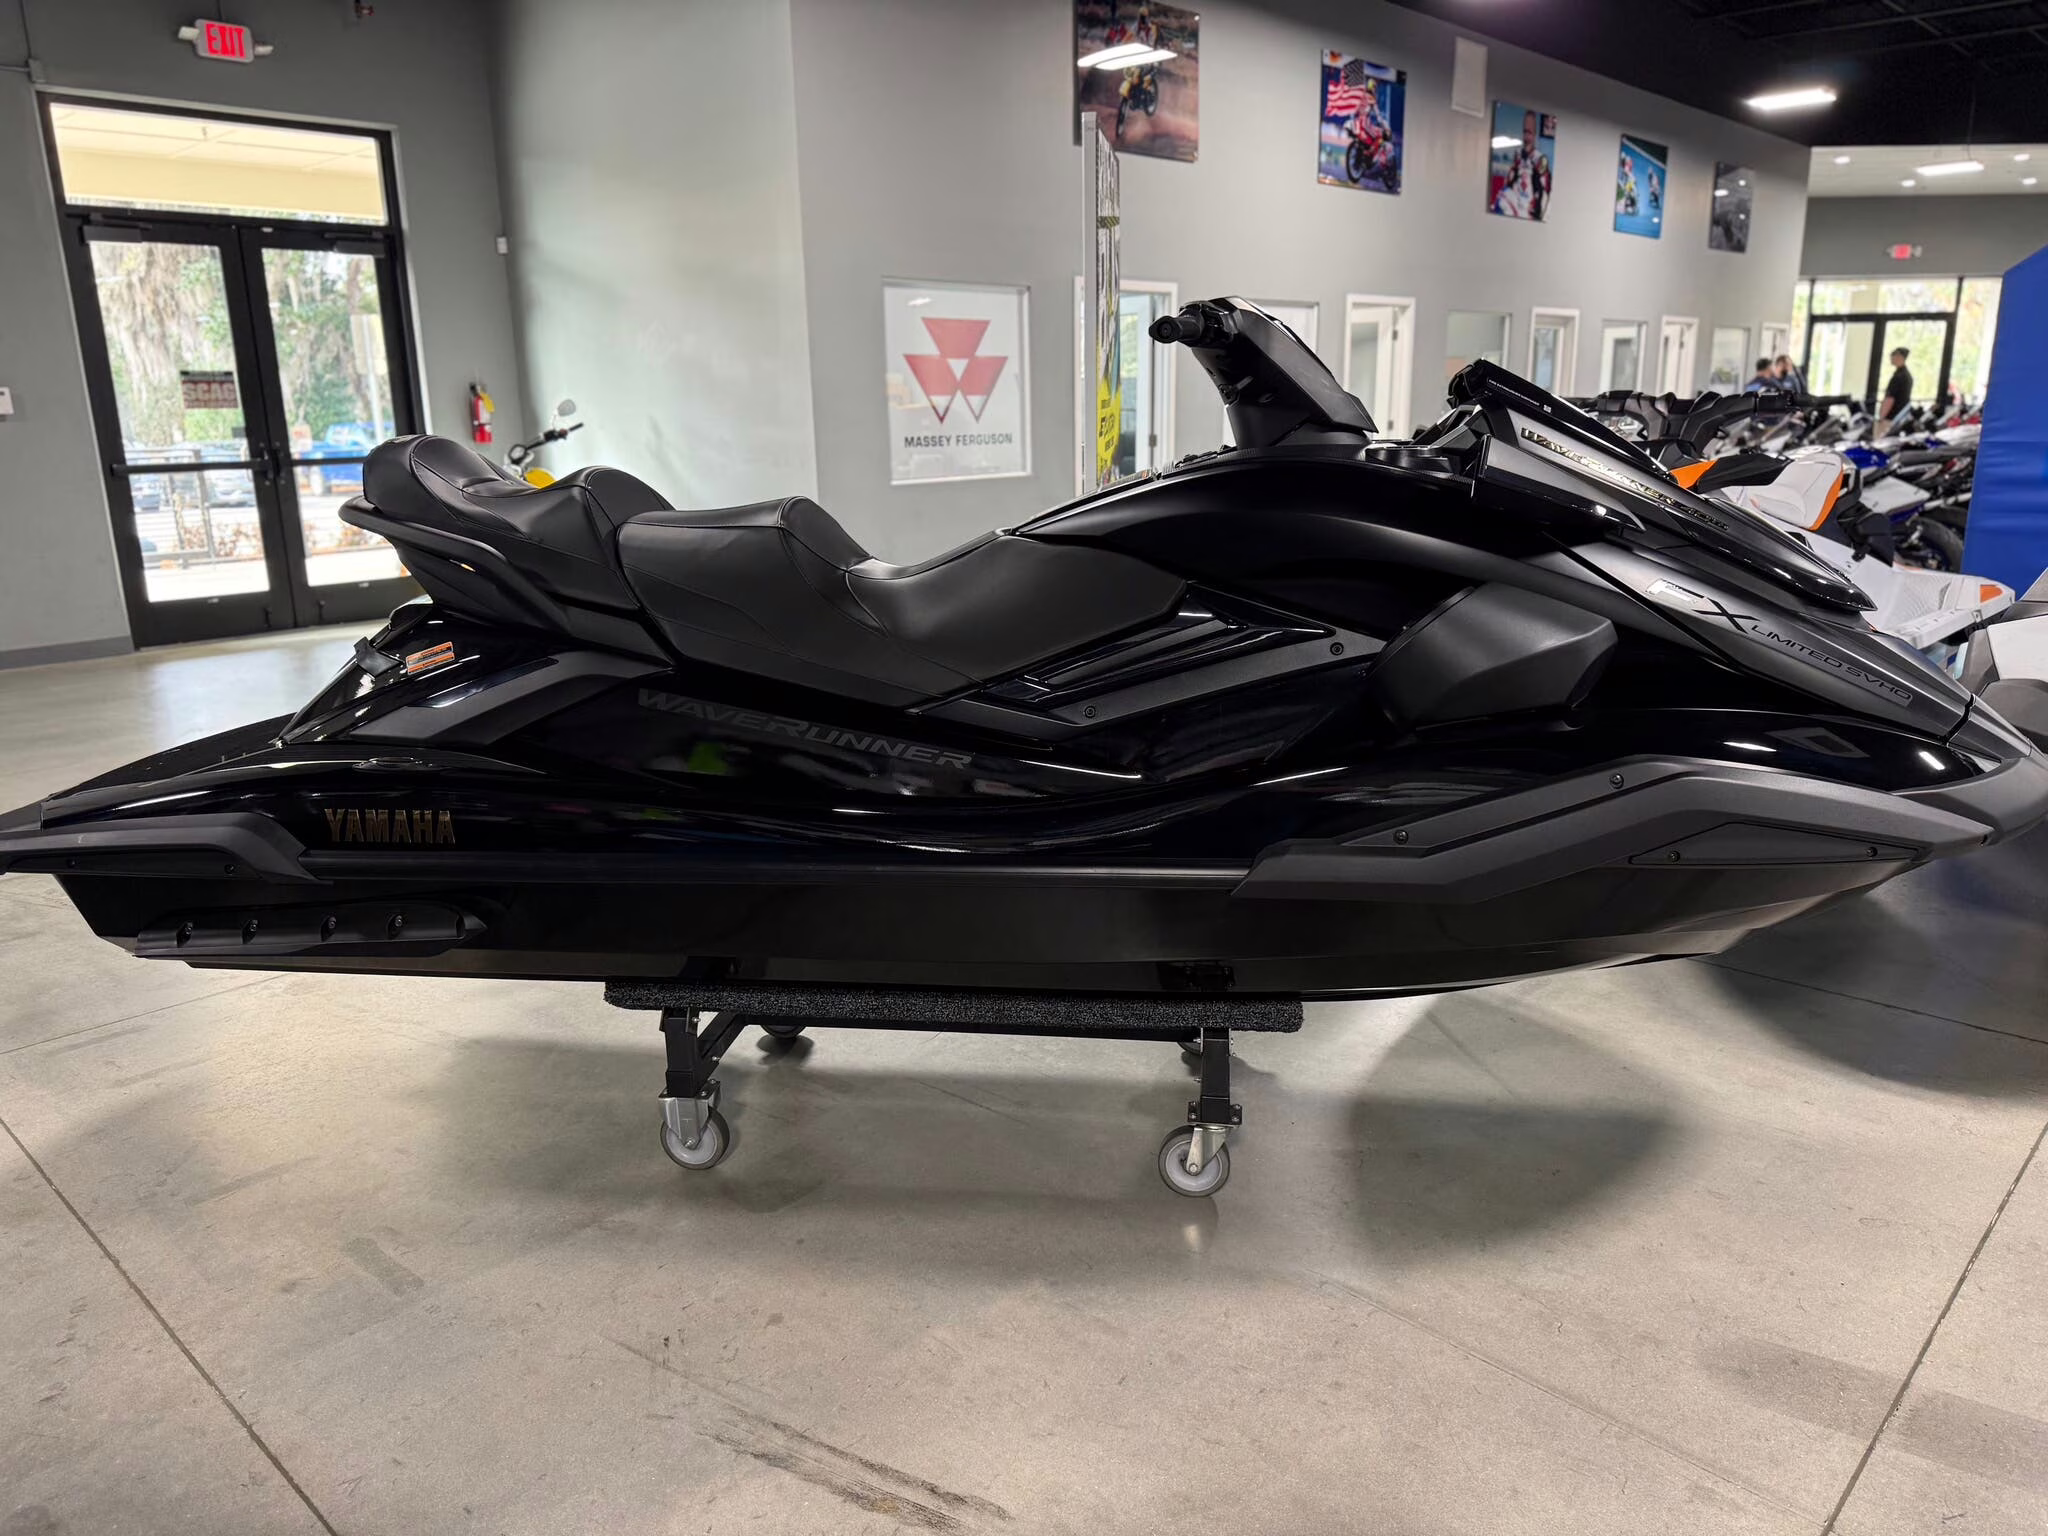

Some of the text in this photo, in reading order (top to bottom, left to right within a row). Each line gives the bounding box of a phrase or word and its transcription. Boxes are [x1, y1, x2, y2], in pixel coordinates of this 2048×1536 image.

[206, 23, 245, 57] EXIT
[904, 433, 1013, 448] MASSEY FERGUSON
[1646, 578, 1911, 701] FX LIMITED SVHO
[638, 687, 973, 769] WAVERUNNER
[324, 808, 456, 843] YAMAHA
